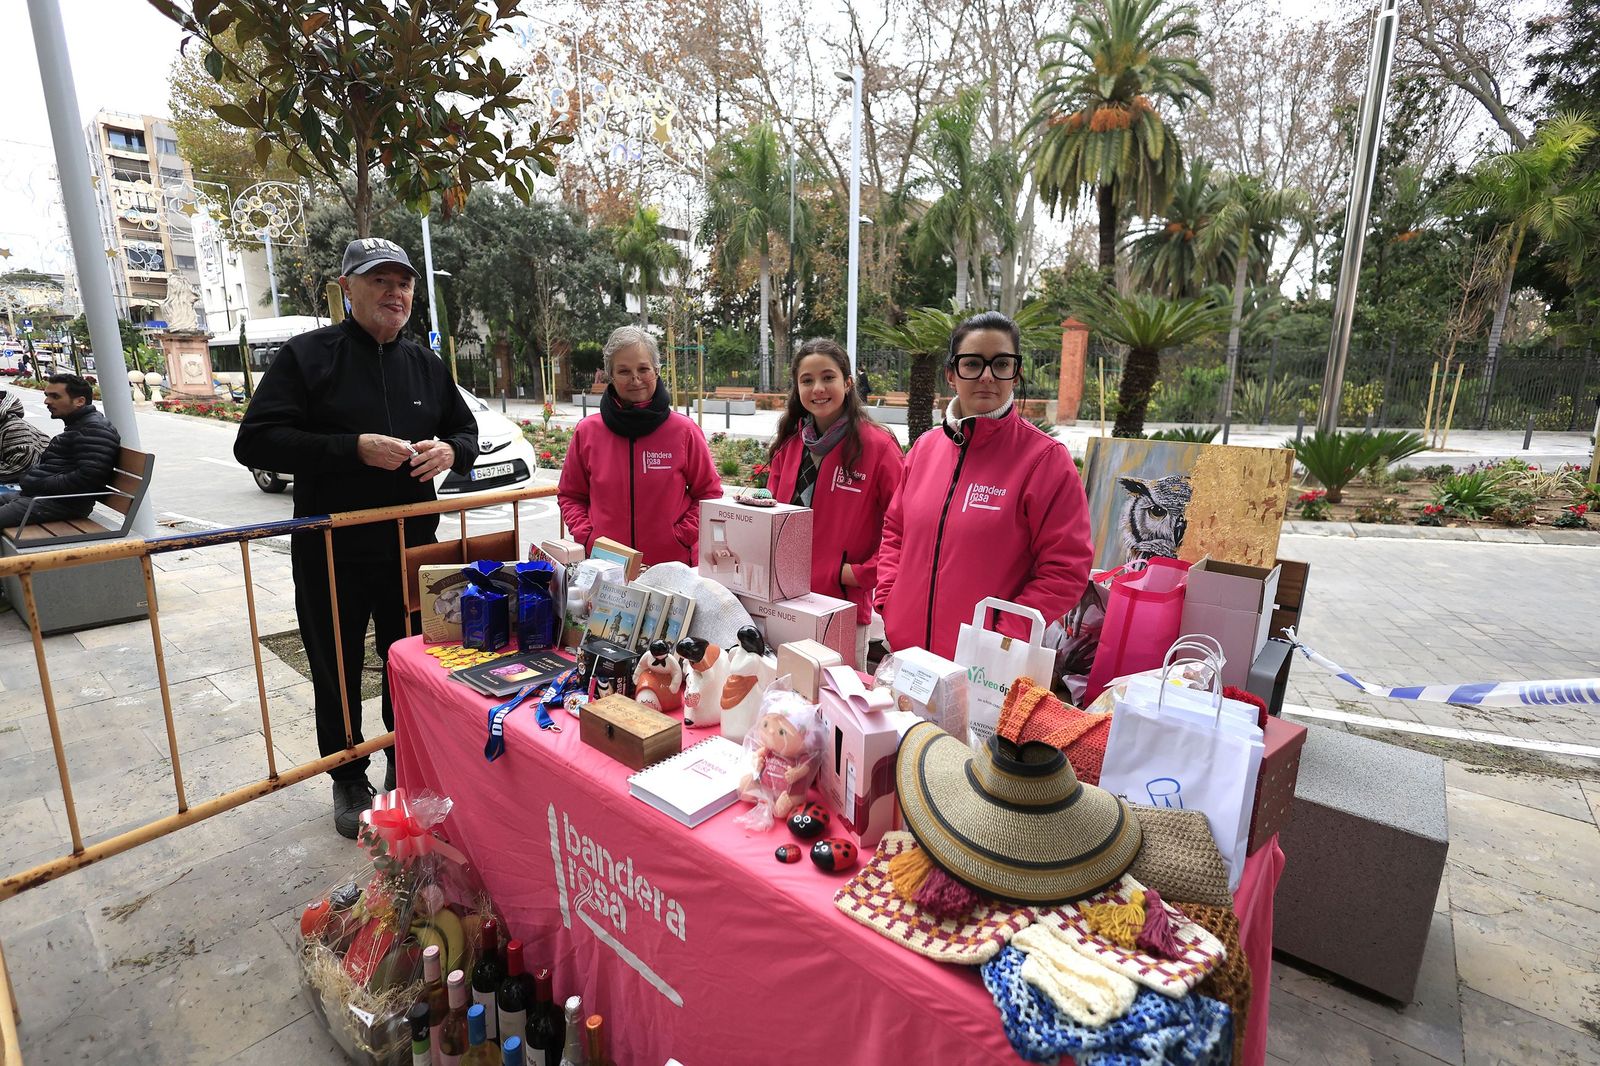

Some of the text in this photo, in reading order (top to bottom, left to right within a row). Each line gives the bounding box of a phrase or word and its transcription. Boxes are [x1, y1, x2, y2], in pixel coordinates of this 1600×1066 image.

[362, 237, 400, 252] NYC
[646, 450, 673, 459] bandera
[646, 457, 661, 465] rosa
[476, 466, 496, 479] 637
[836, 475, 853, 485] roa
[972, 483, 1007, 497] bandera
[970, 492, 989, 503] rosa
[718, 510, 753, 524] ROSE NUDE
[758, 606, 797, 623] ROSE NUDE
[563, 811, 686, 942] bandera
